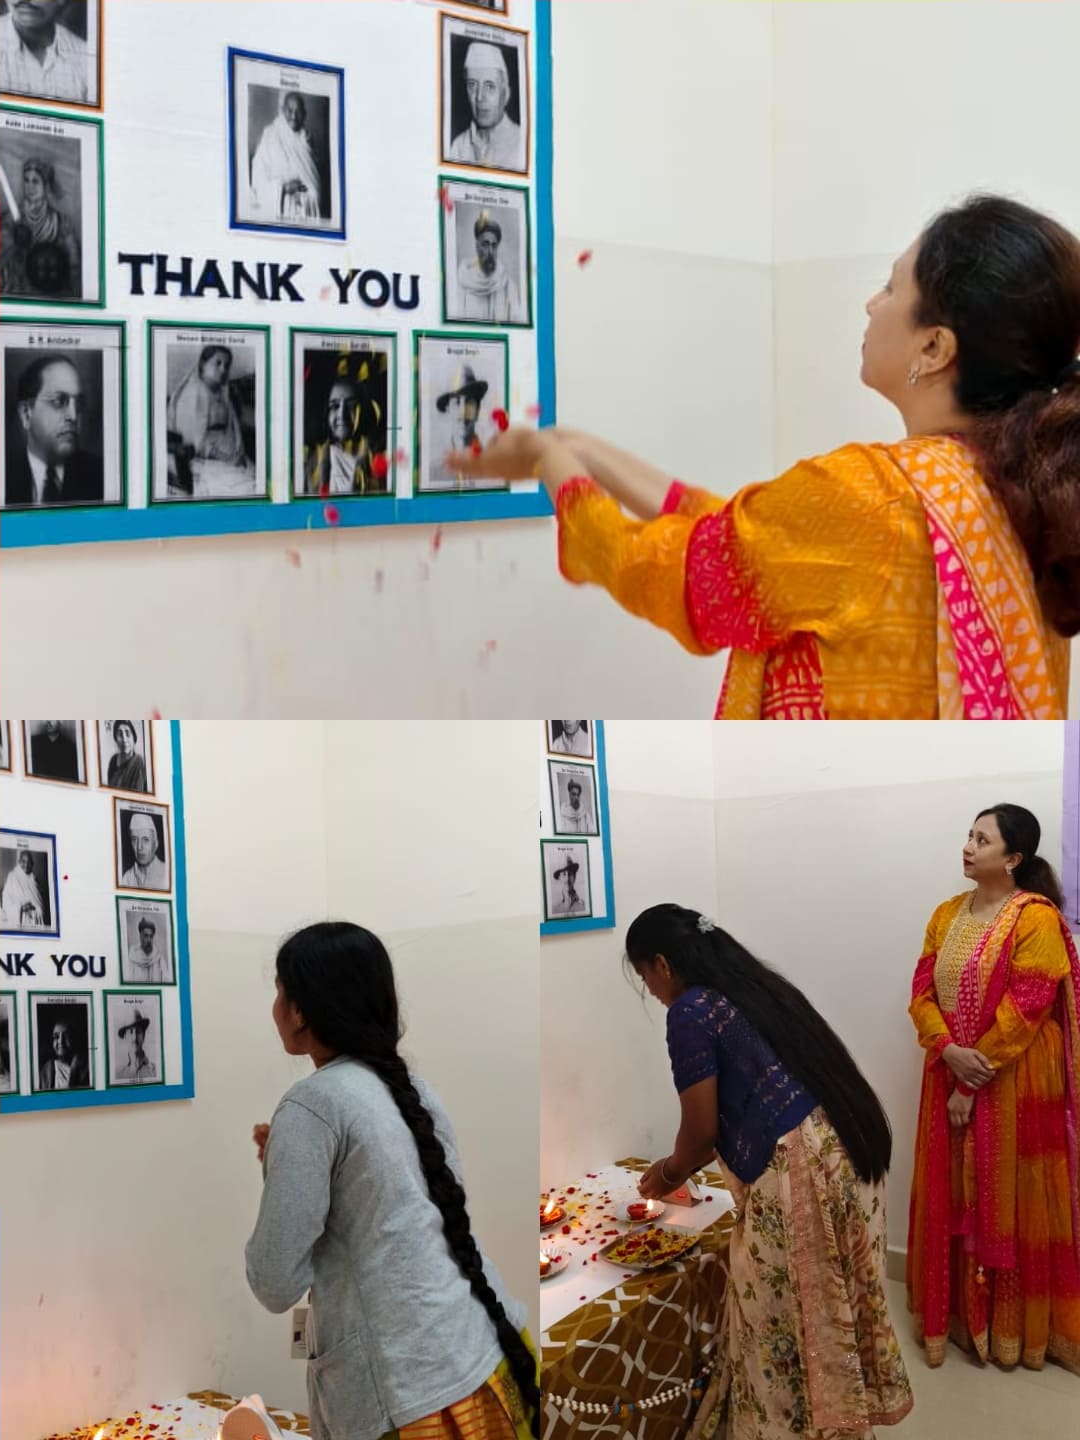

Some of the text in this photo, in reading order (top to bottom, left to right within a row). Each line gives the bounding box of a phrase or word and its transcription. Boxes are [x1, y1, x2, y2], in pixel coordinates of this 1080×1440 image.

[118, 252, 421, 311] THANK YOU
[49, 954, 107, 979] YOU
